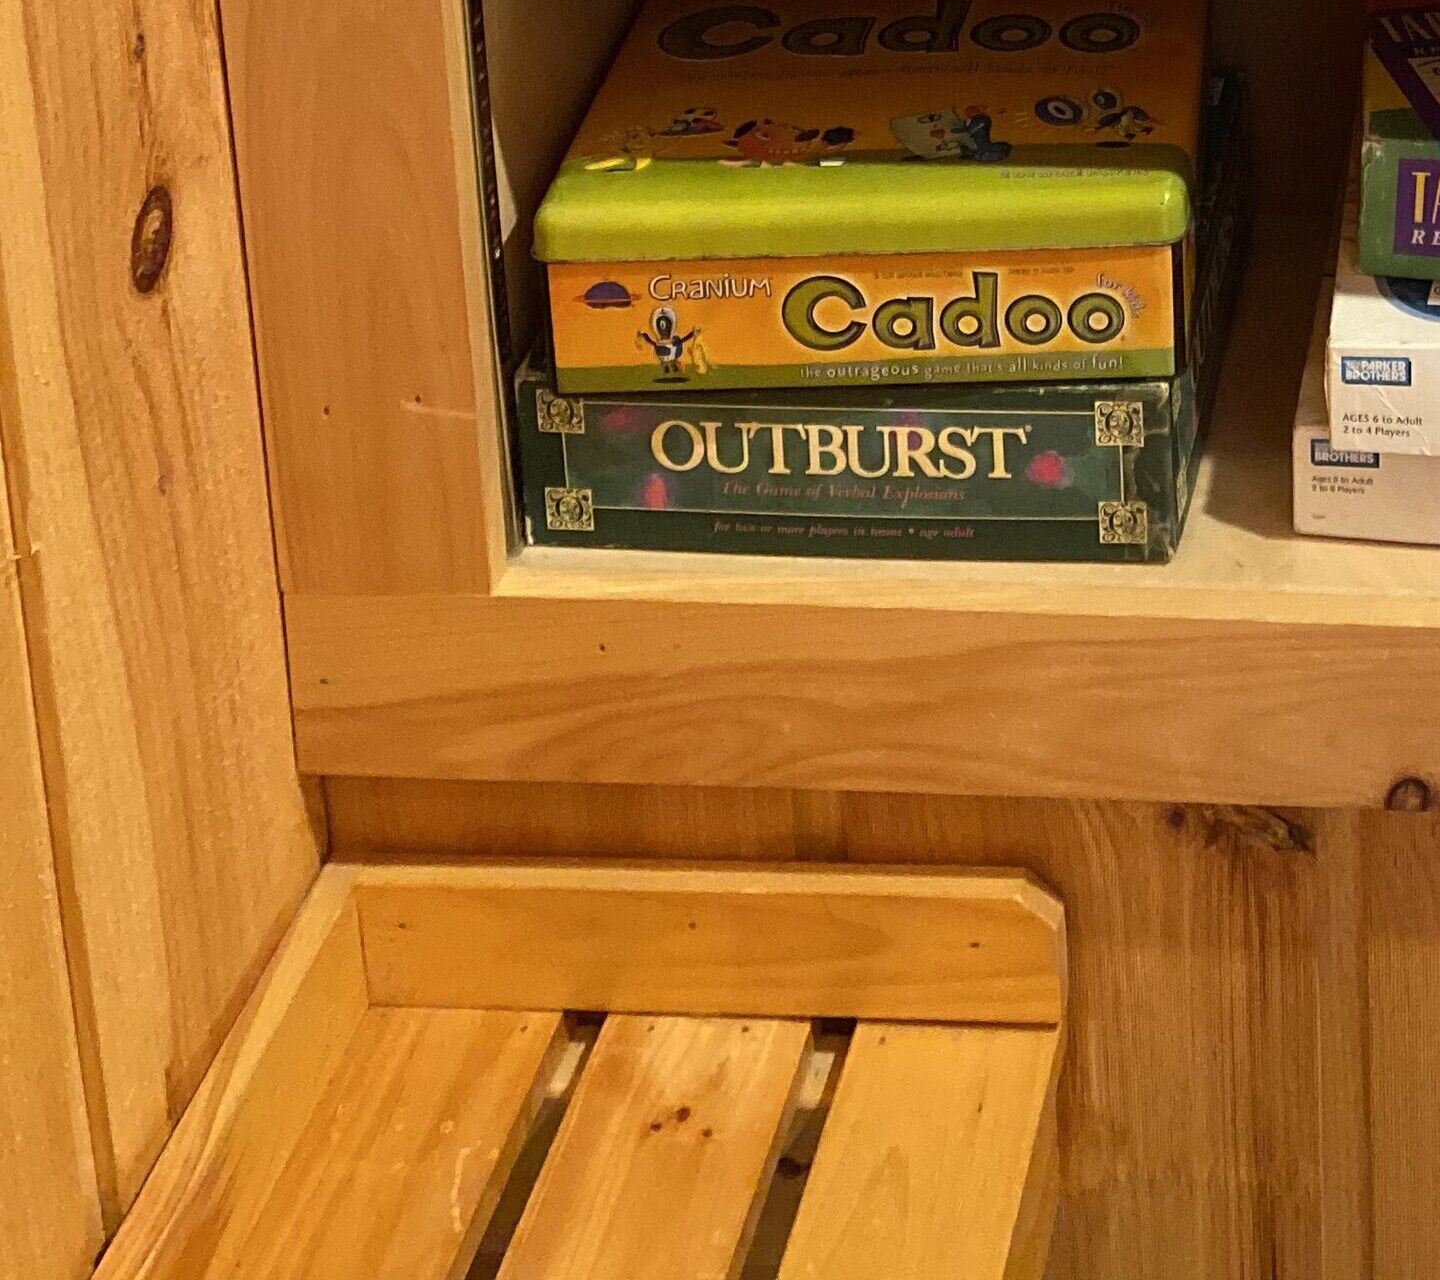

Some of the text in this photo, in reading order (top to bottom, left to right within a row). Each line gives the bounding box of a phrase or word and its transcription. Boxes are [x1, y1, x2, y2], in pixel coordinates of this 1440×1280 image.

[648, 273, 773, 301] CRANIUM
[781, 270, 1126, 353] Cadoo
[826, 362, 919, 380] outrageous
[1362, 360, 1407, 372] PARKER
[1345, 369, 1407, 382] BROTHERS
[1343, 413, 1423, 426] AGES Adult
[1379, 426, 1410, 438] Players
[650, 419, 1027, 480] OUTBURST
